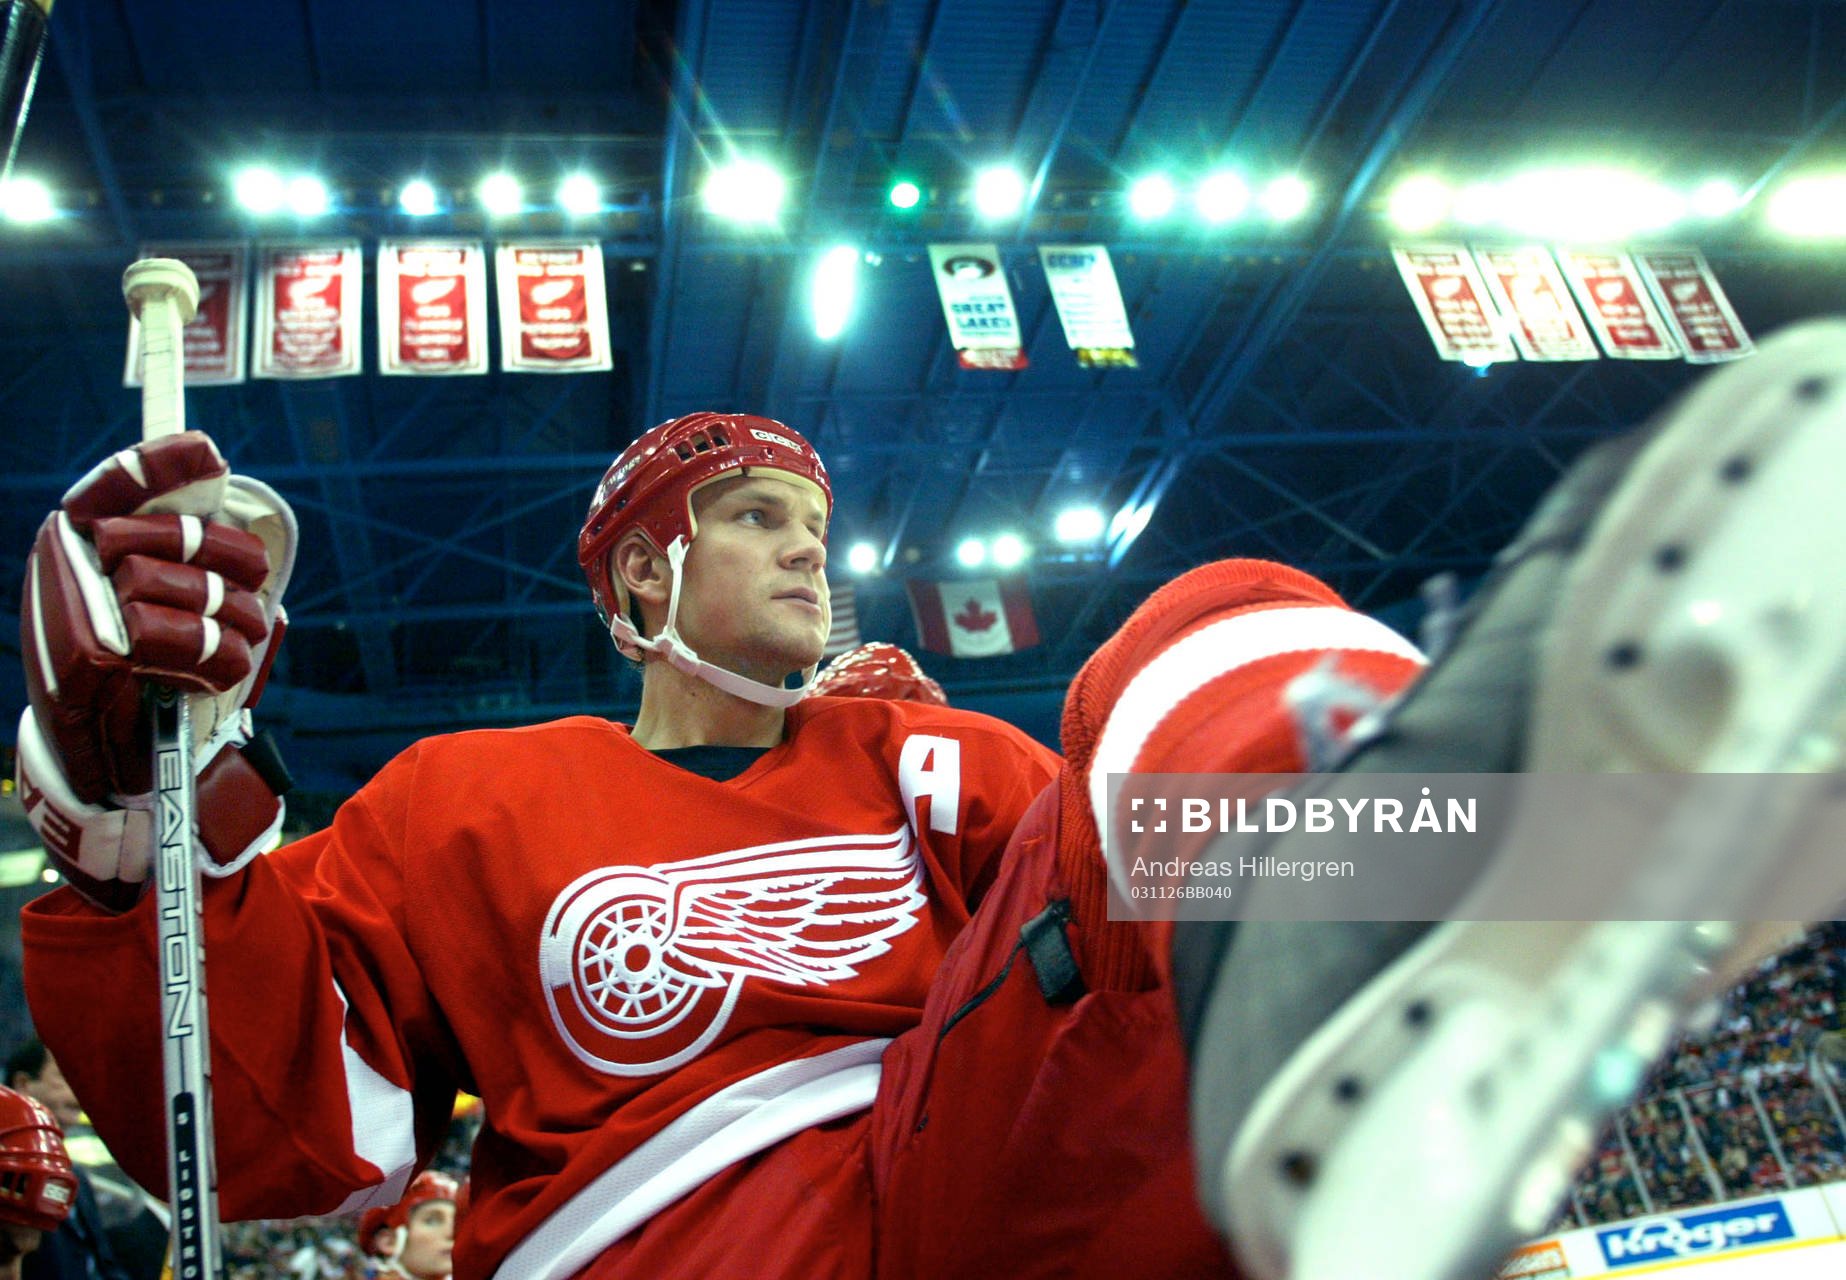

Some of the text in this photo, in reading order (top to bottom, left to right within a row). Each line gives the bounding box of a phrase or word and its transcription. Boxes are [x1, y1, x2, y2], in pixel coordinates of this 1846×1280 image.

[898, 733, 960, 838] A
[157, 749, 193, 1038] EASTON
[1607, 1213, 1778, 1259] Kroger
